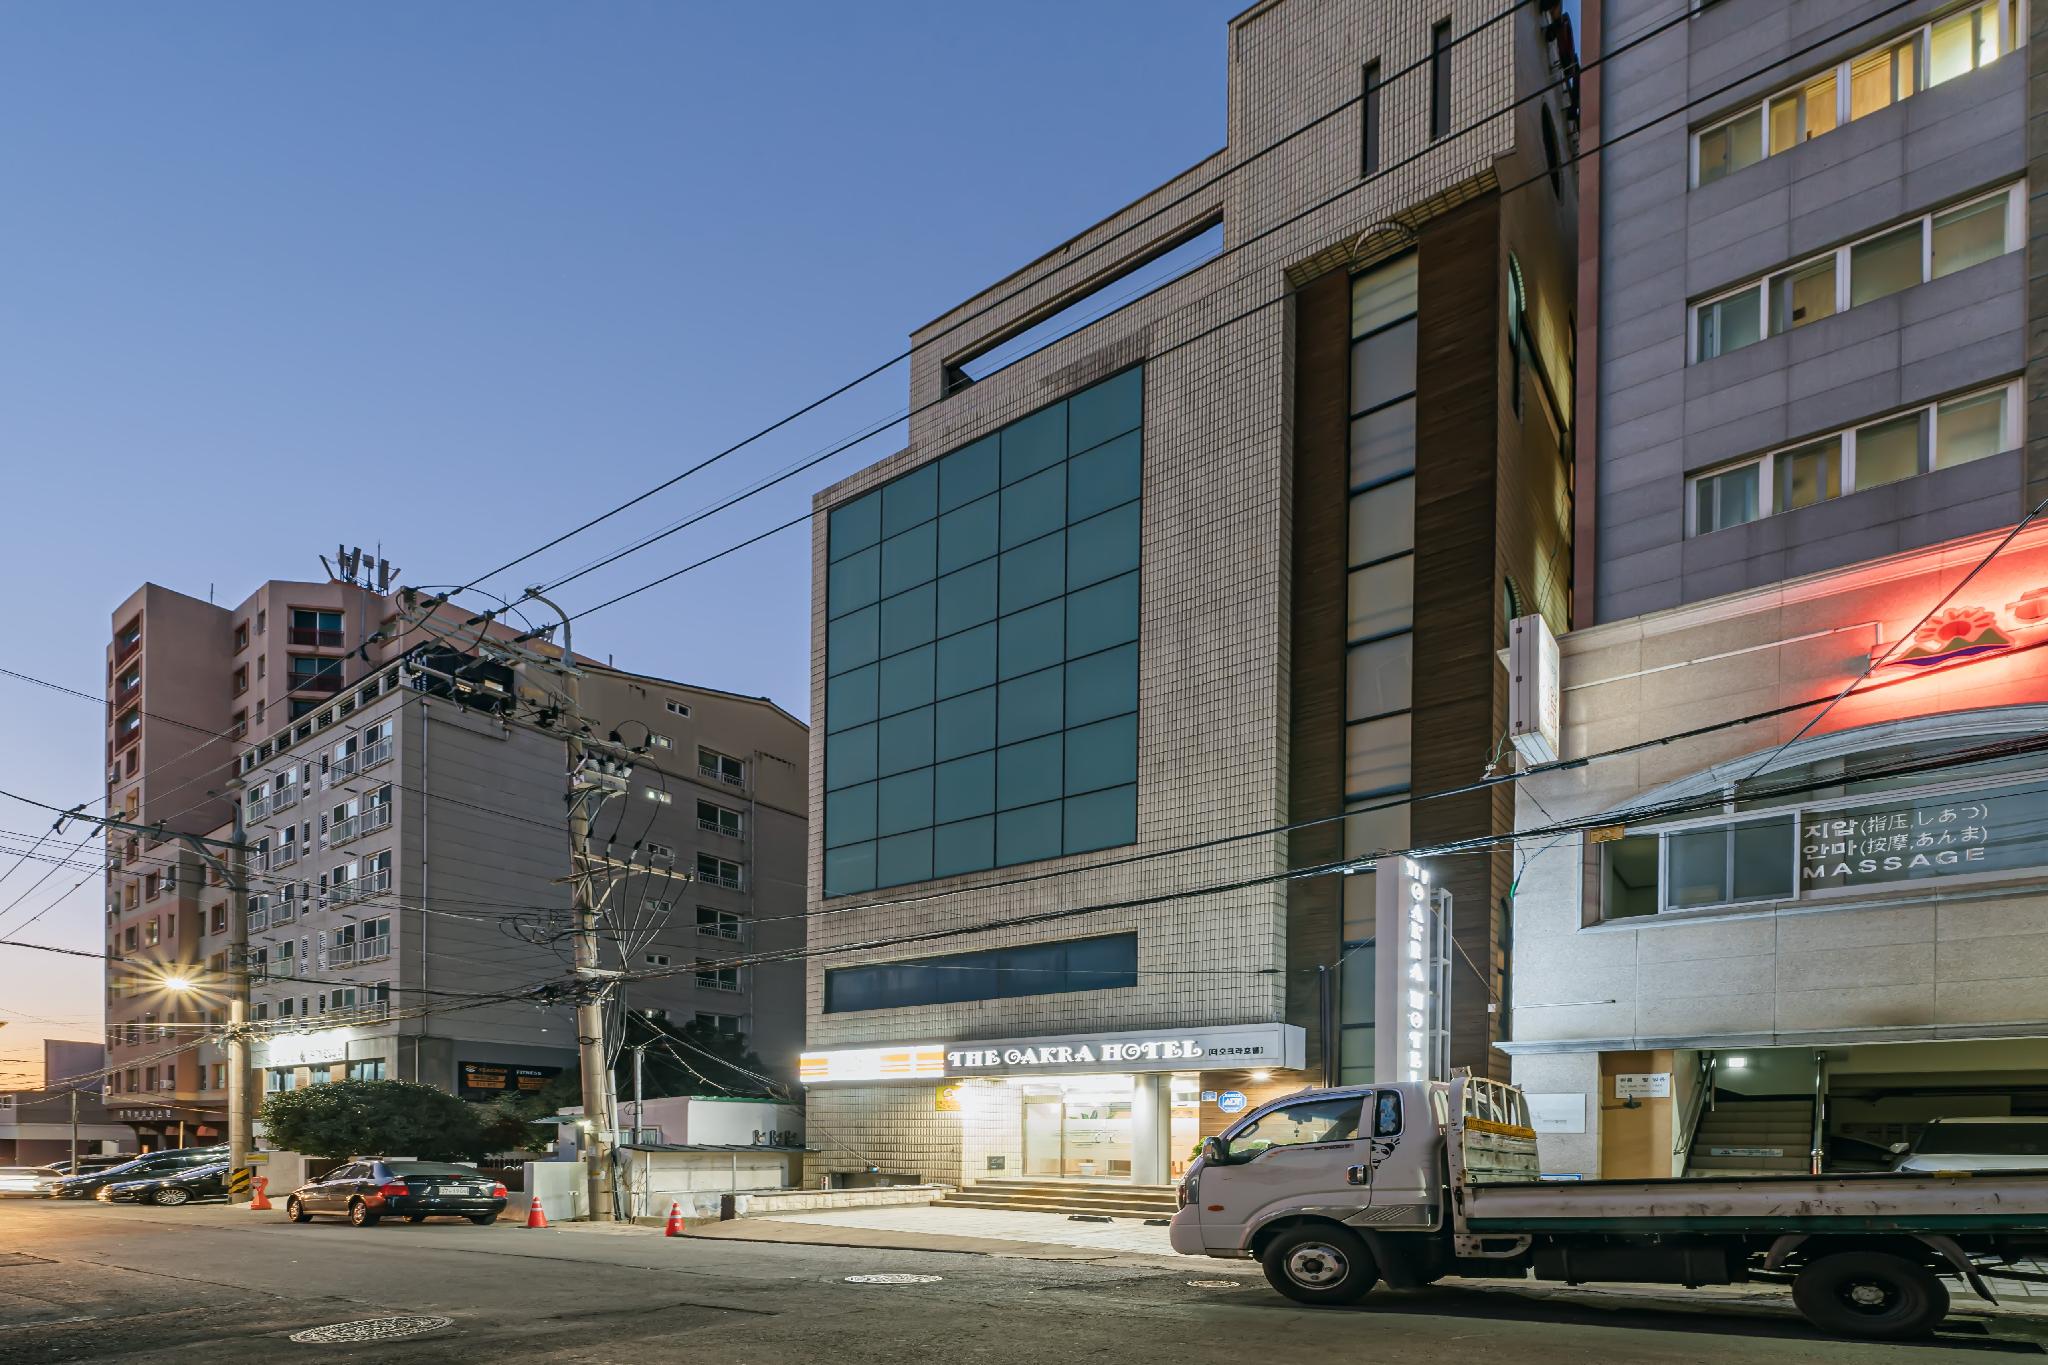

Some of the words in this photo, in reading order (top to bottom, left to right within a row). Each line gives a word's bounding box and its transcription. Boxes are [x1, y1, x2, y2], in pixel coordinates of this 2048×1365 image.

[1802, 847, 1986, 879] MASSAGE
[947, 1050, 1001, 1068] THE
[1004, 1045, 1095, 1065] OAKRA
[1101, 1039, 1203, 1061] HOTEL
